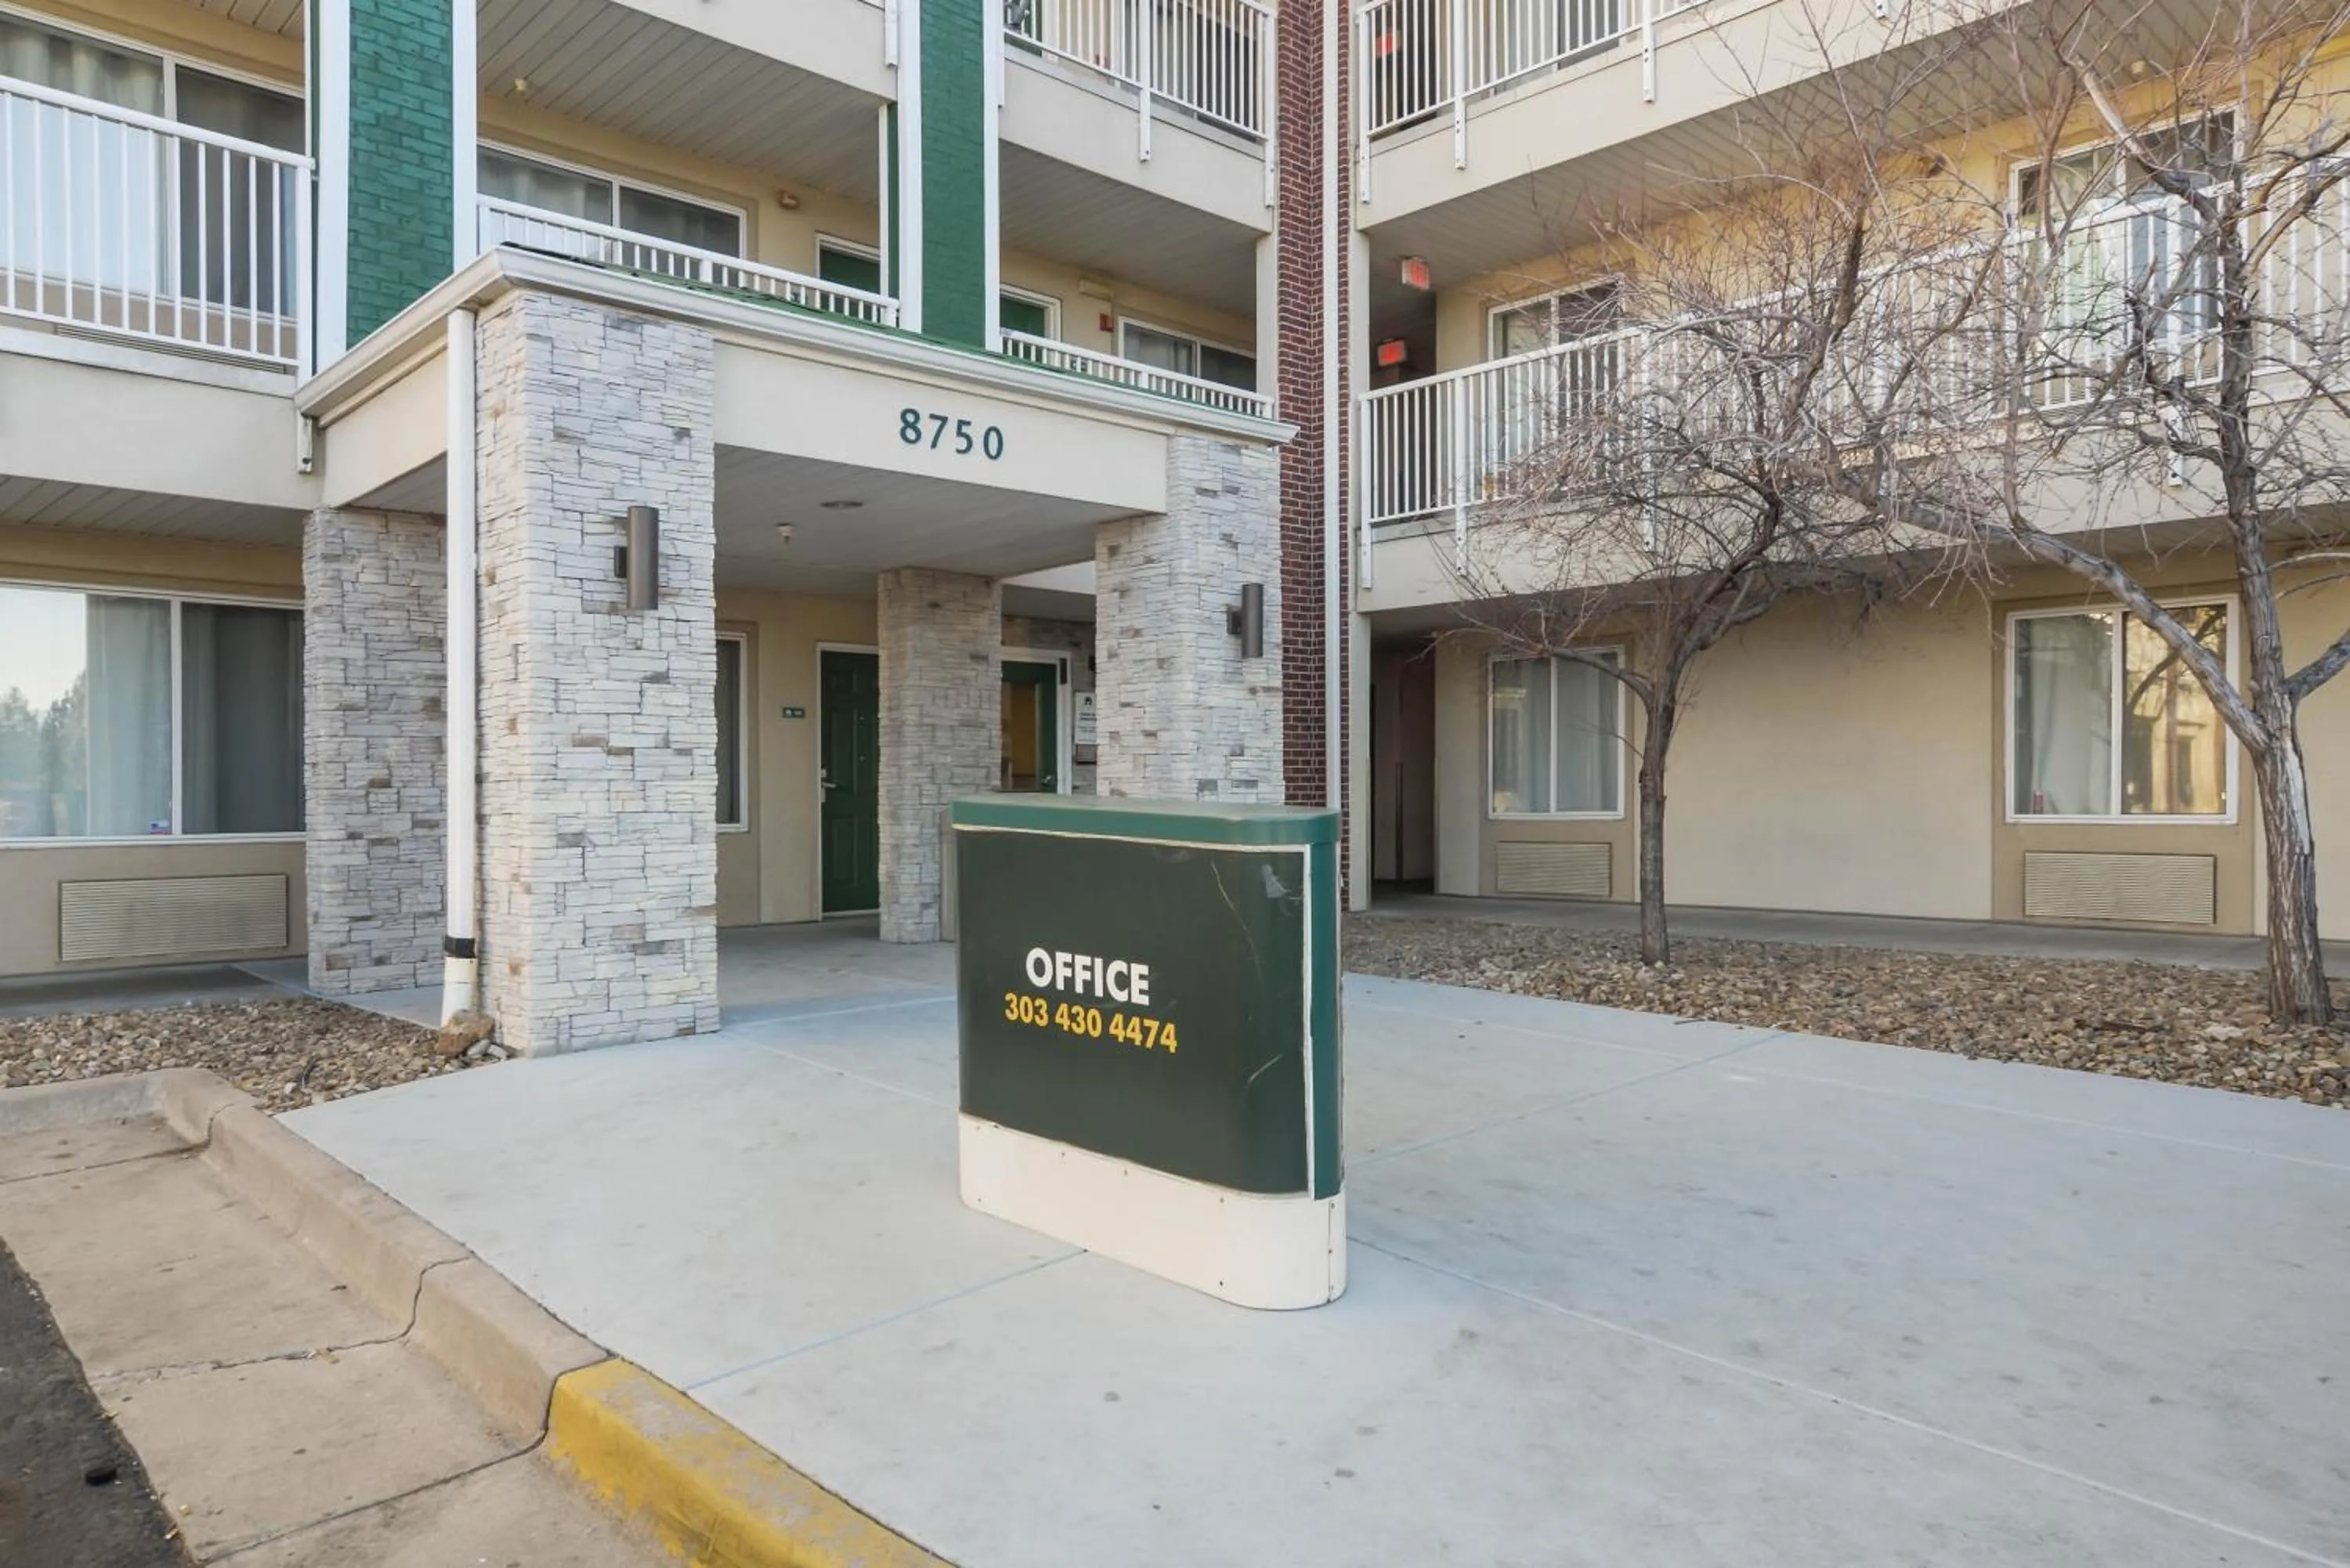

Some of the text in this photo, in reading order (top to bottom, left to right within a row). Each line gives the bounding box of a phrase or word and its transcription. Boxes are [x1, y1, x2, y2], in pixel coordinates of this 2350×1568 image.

[899, 407, 1003, 461] 8750
[1025, 947, 1149, 1006] OFFICE
[1004, 992, 1178, 1053] 303 430 4474
